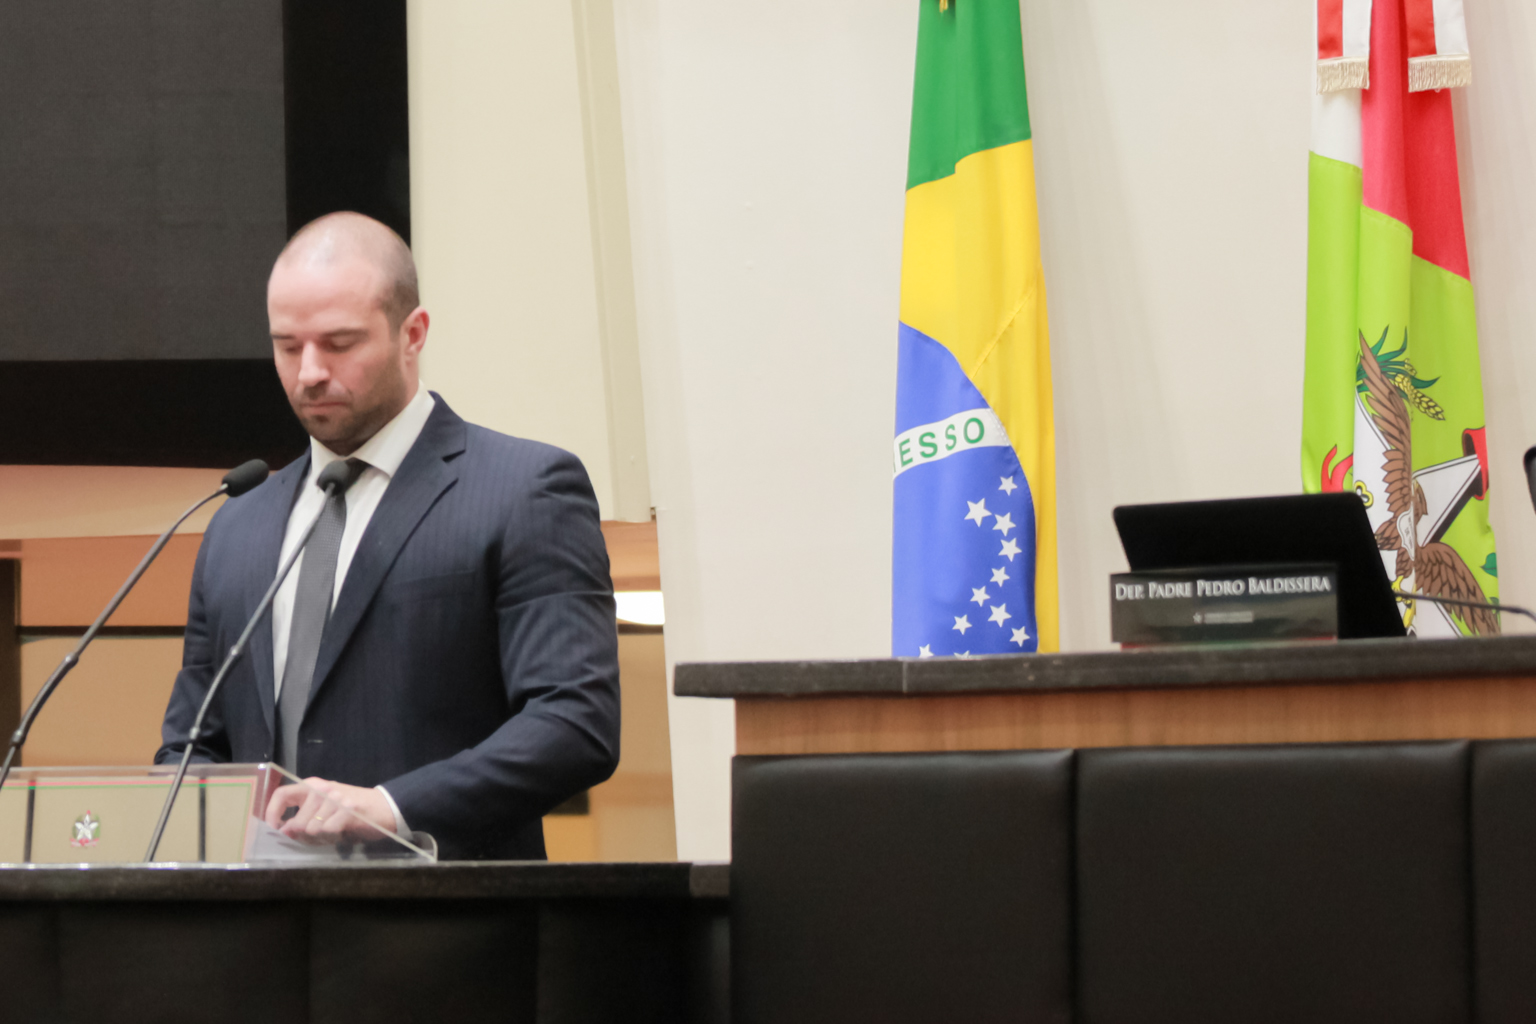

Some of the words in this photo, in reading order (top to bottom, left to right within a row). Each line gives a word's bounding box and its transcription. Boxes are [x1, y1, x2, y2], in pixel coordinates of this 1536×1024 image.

[893, 417, 985, 473] ESSO
[1148, 581, 1193, 599] PADRE
[1196, 579, 1246, 597] PEDRO
[1248, 576, 1332, 595] BALDISSERA
